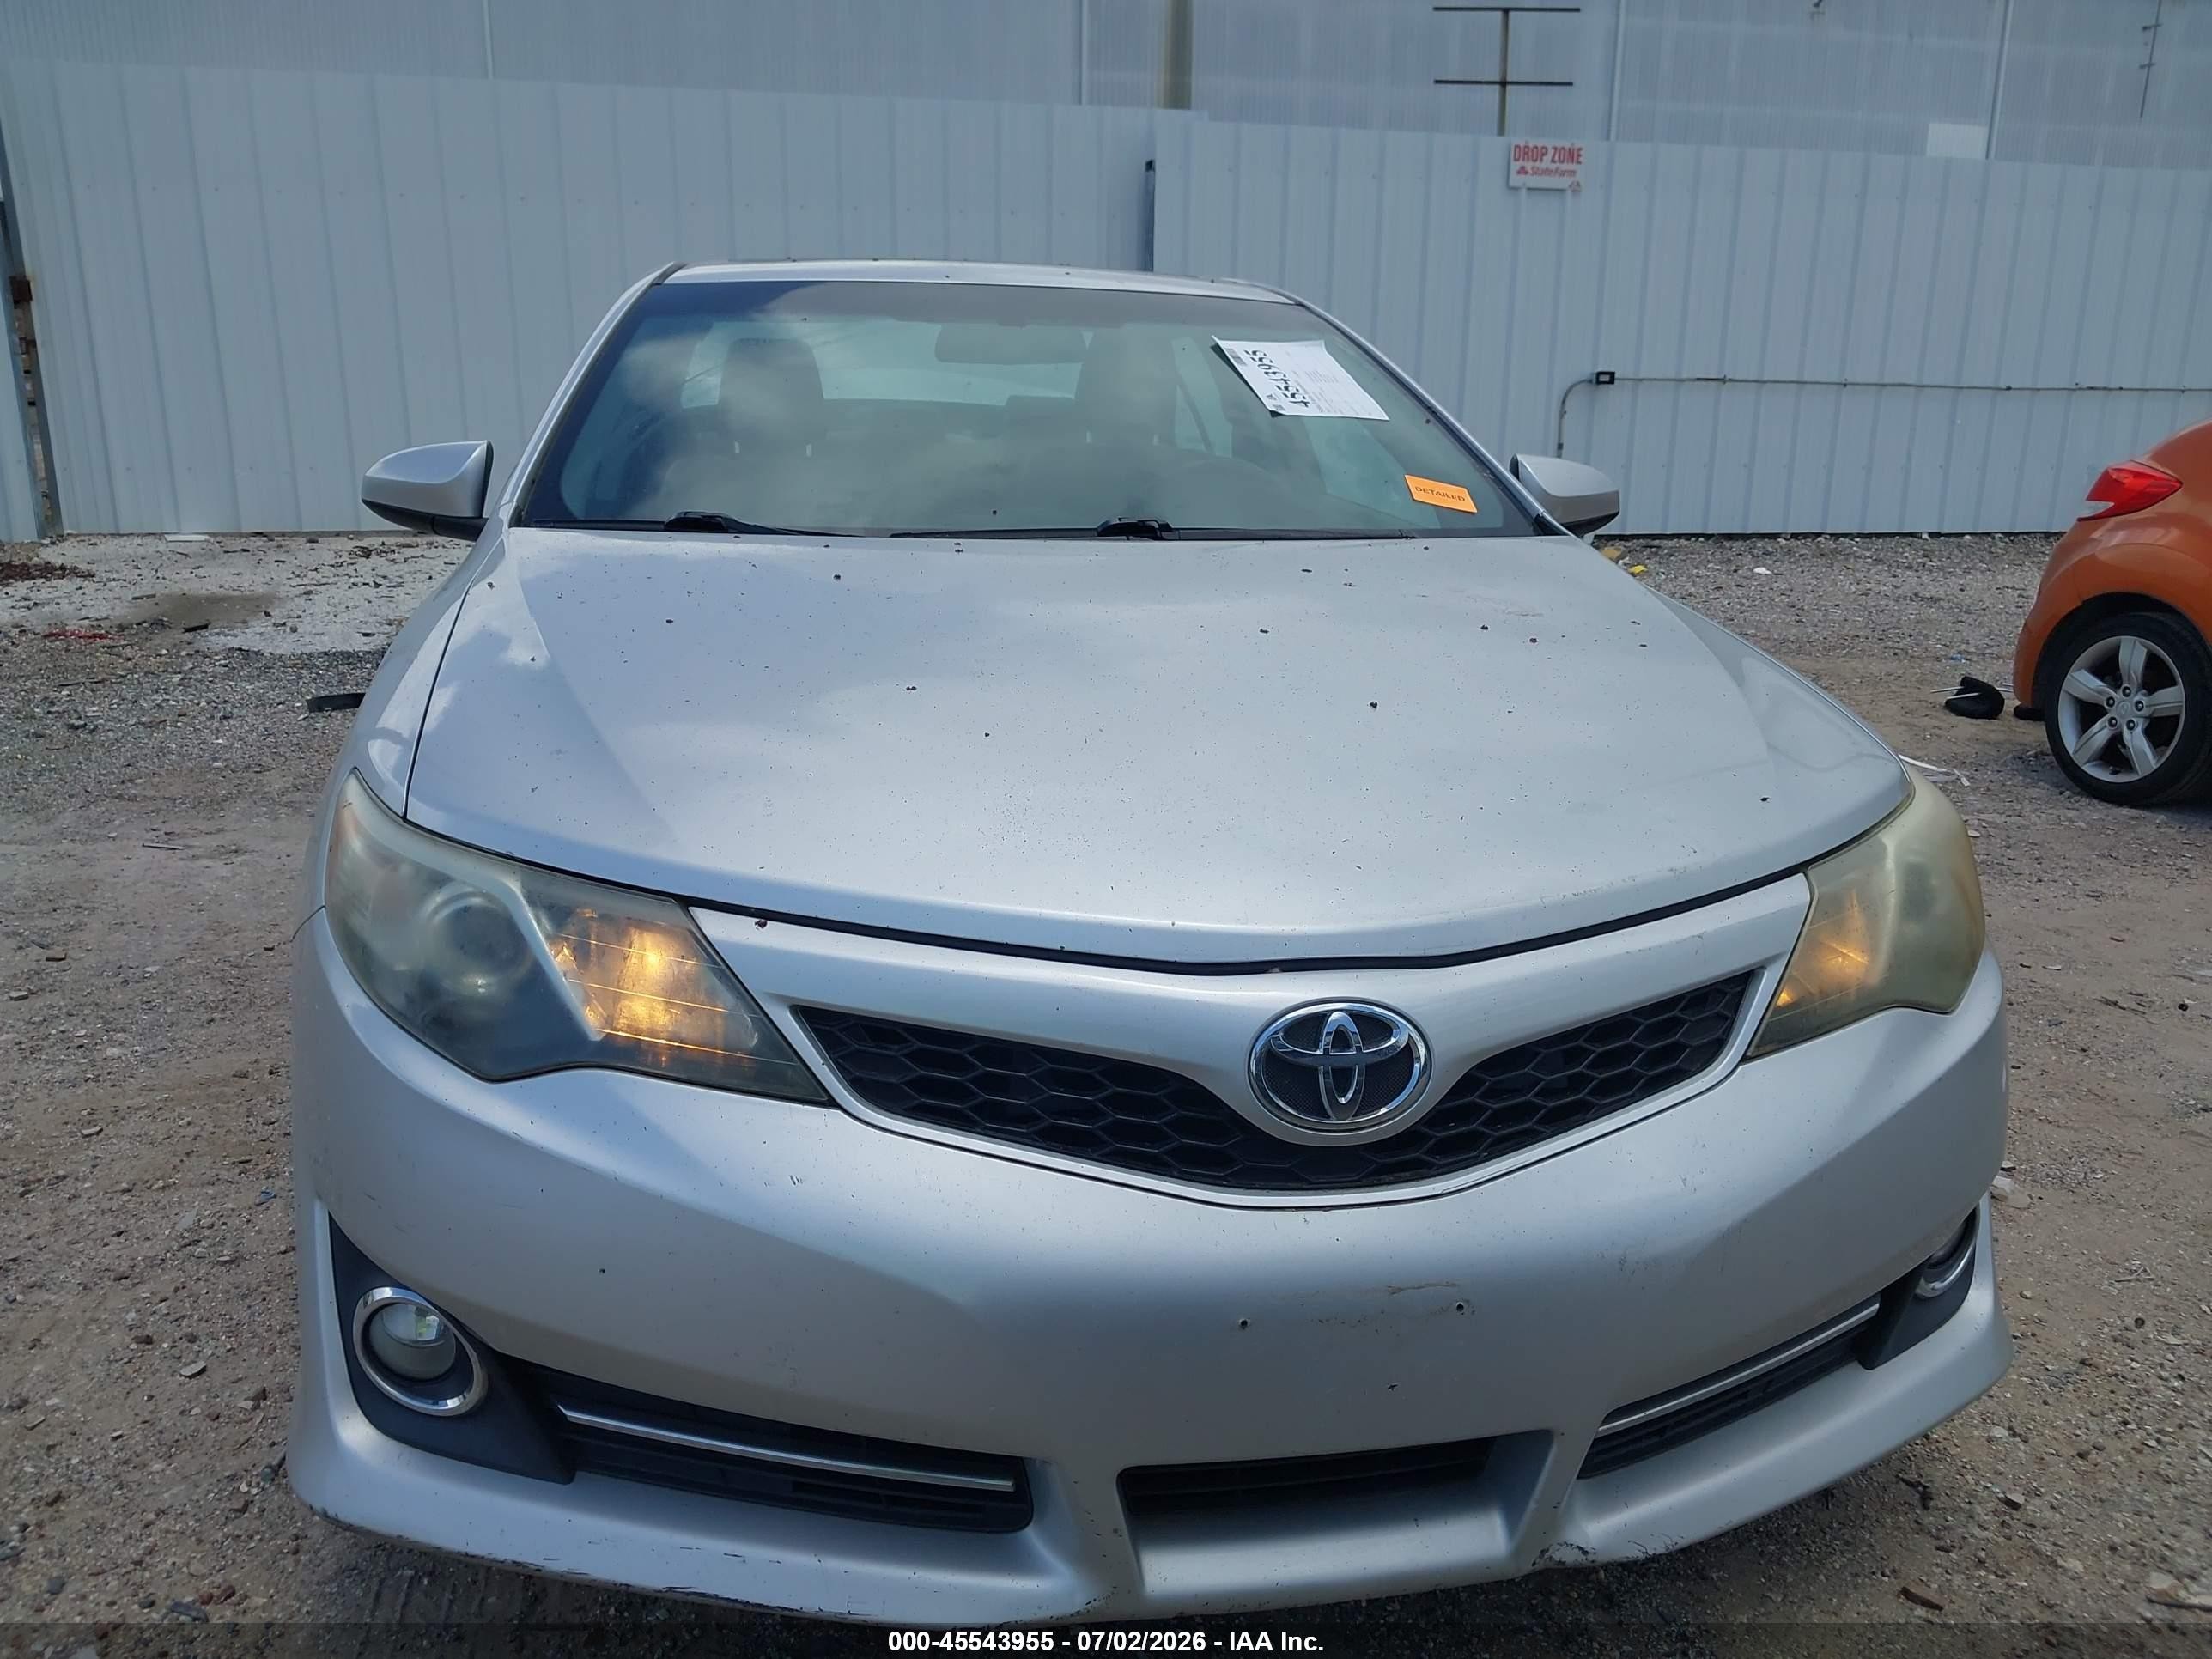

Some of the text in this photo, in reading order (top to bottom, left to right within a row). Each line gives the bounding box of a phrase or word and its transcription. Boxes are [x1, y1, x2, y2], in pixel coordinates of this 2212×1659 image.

[1514, 144, 1583, 164] DROP ZONE
[1244, 349, 1310, 408] 45543955
[1415, 486, 1465, 501] DETAILED
